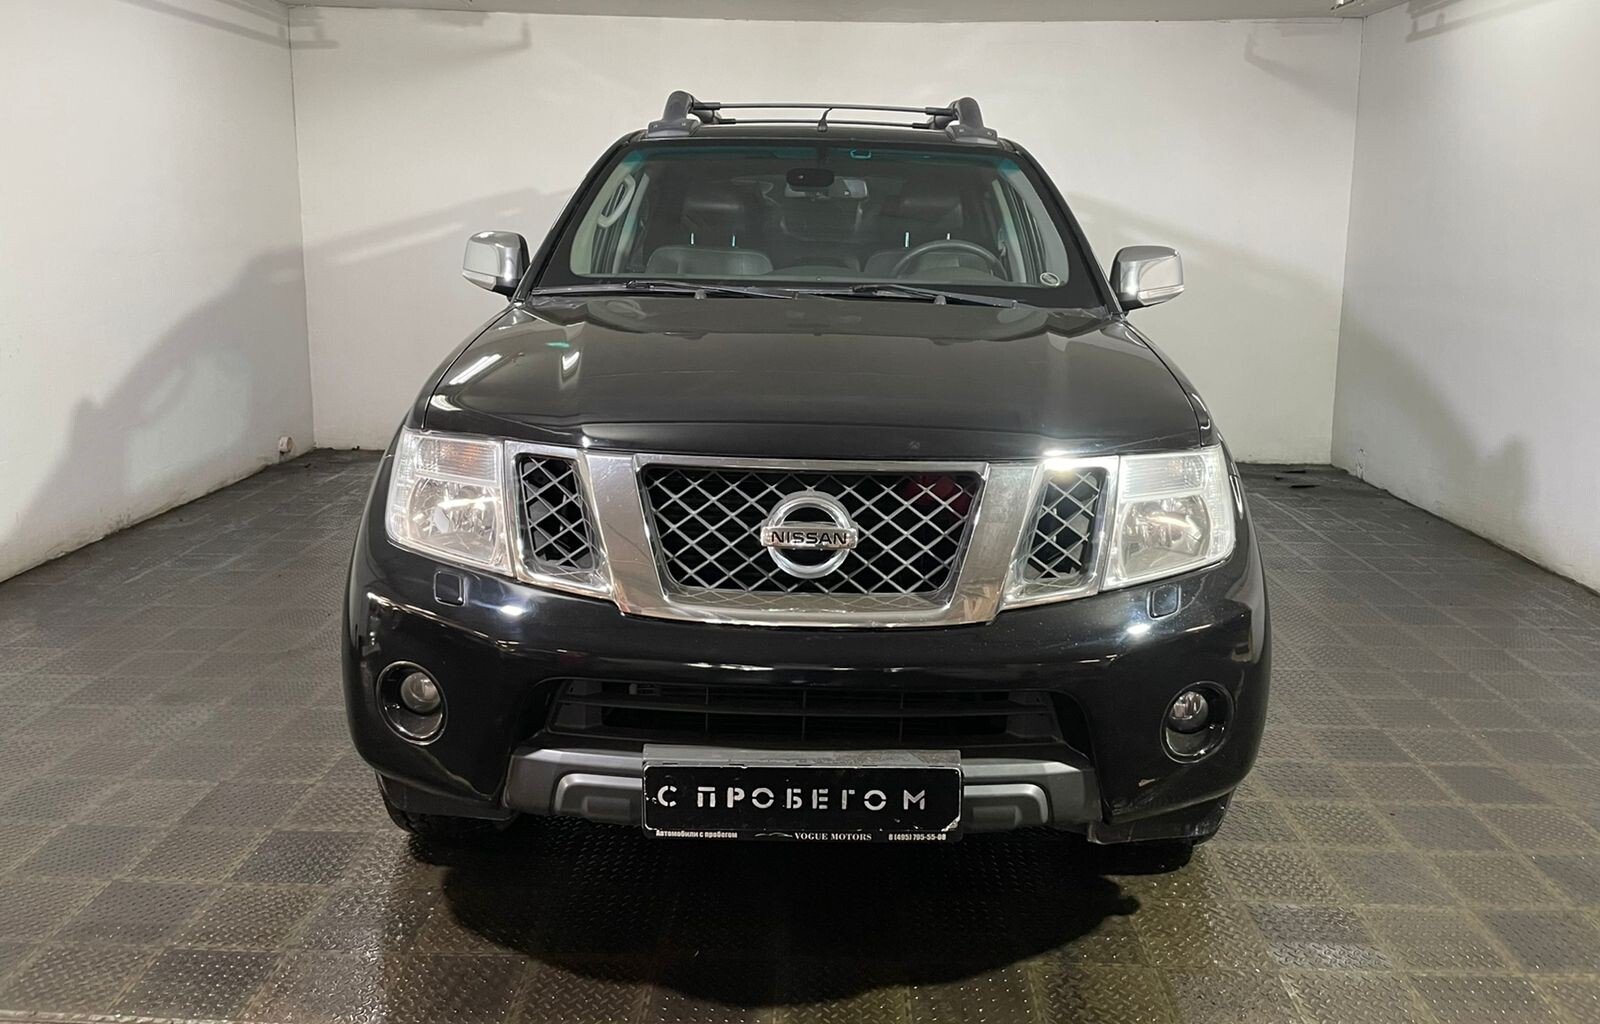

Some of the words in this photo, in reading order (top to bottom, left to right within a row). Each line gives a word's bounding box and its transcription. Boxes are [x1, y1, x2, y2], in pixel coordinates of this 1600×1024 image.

[771, 531, 847, 545] NISSAN
[657, 785, 677, 807] С
[697, 786, 926, 811] ПРОБЕГОМ
[655, 830, 699, 838] Автомобили
[704, 831, 738, 839] пробегом
[794, 832, 828, 841] VOGUE
[830, 832, 872, 841] MOTORS
